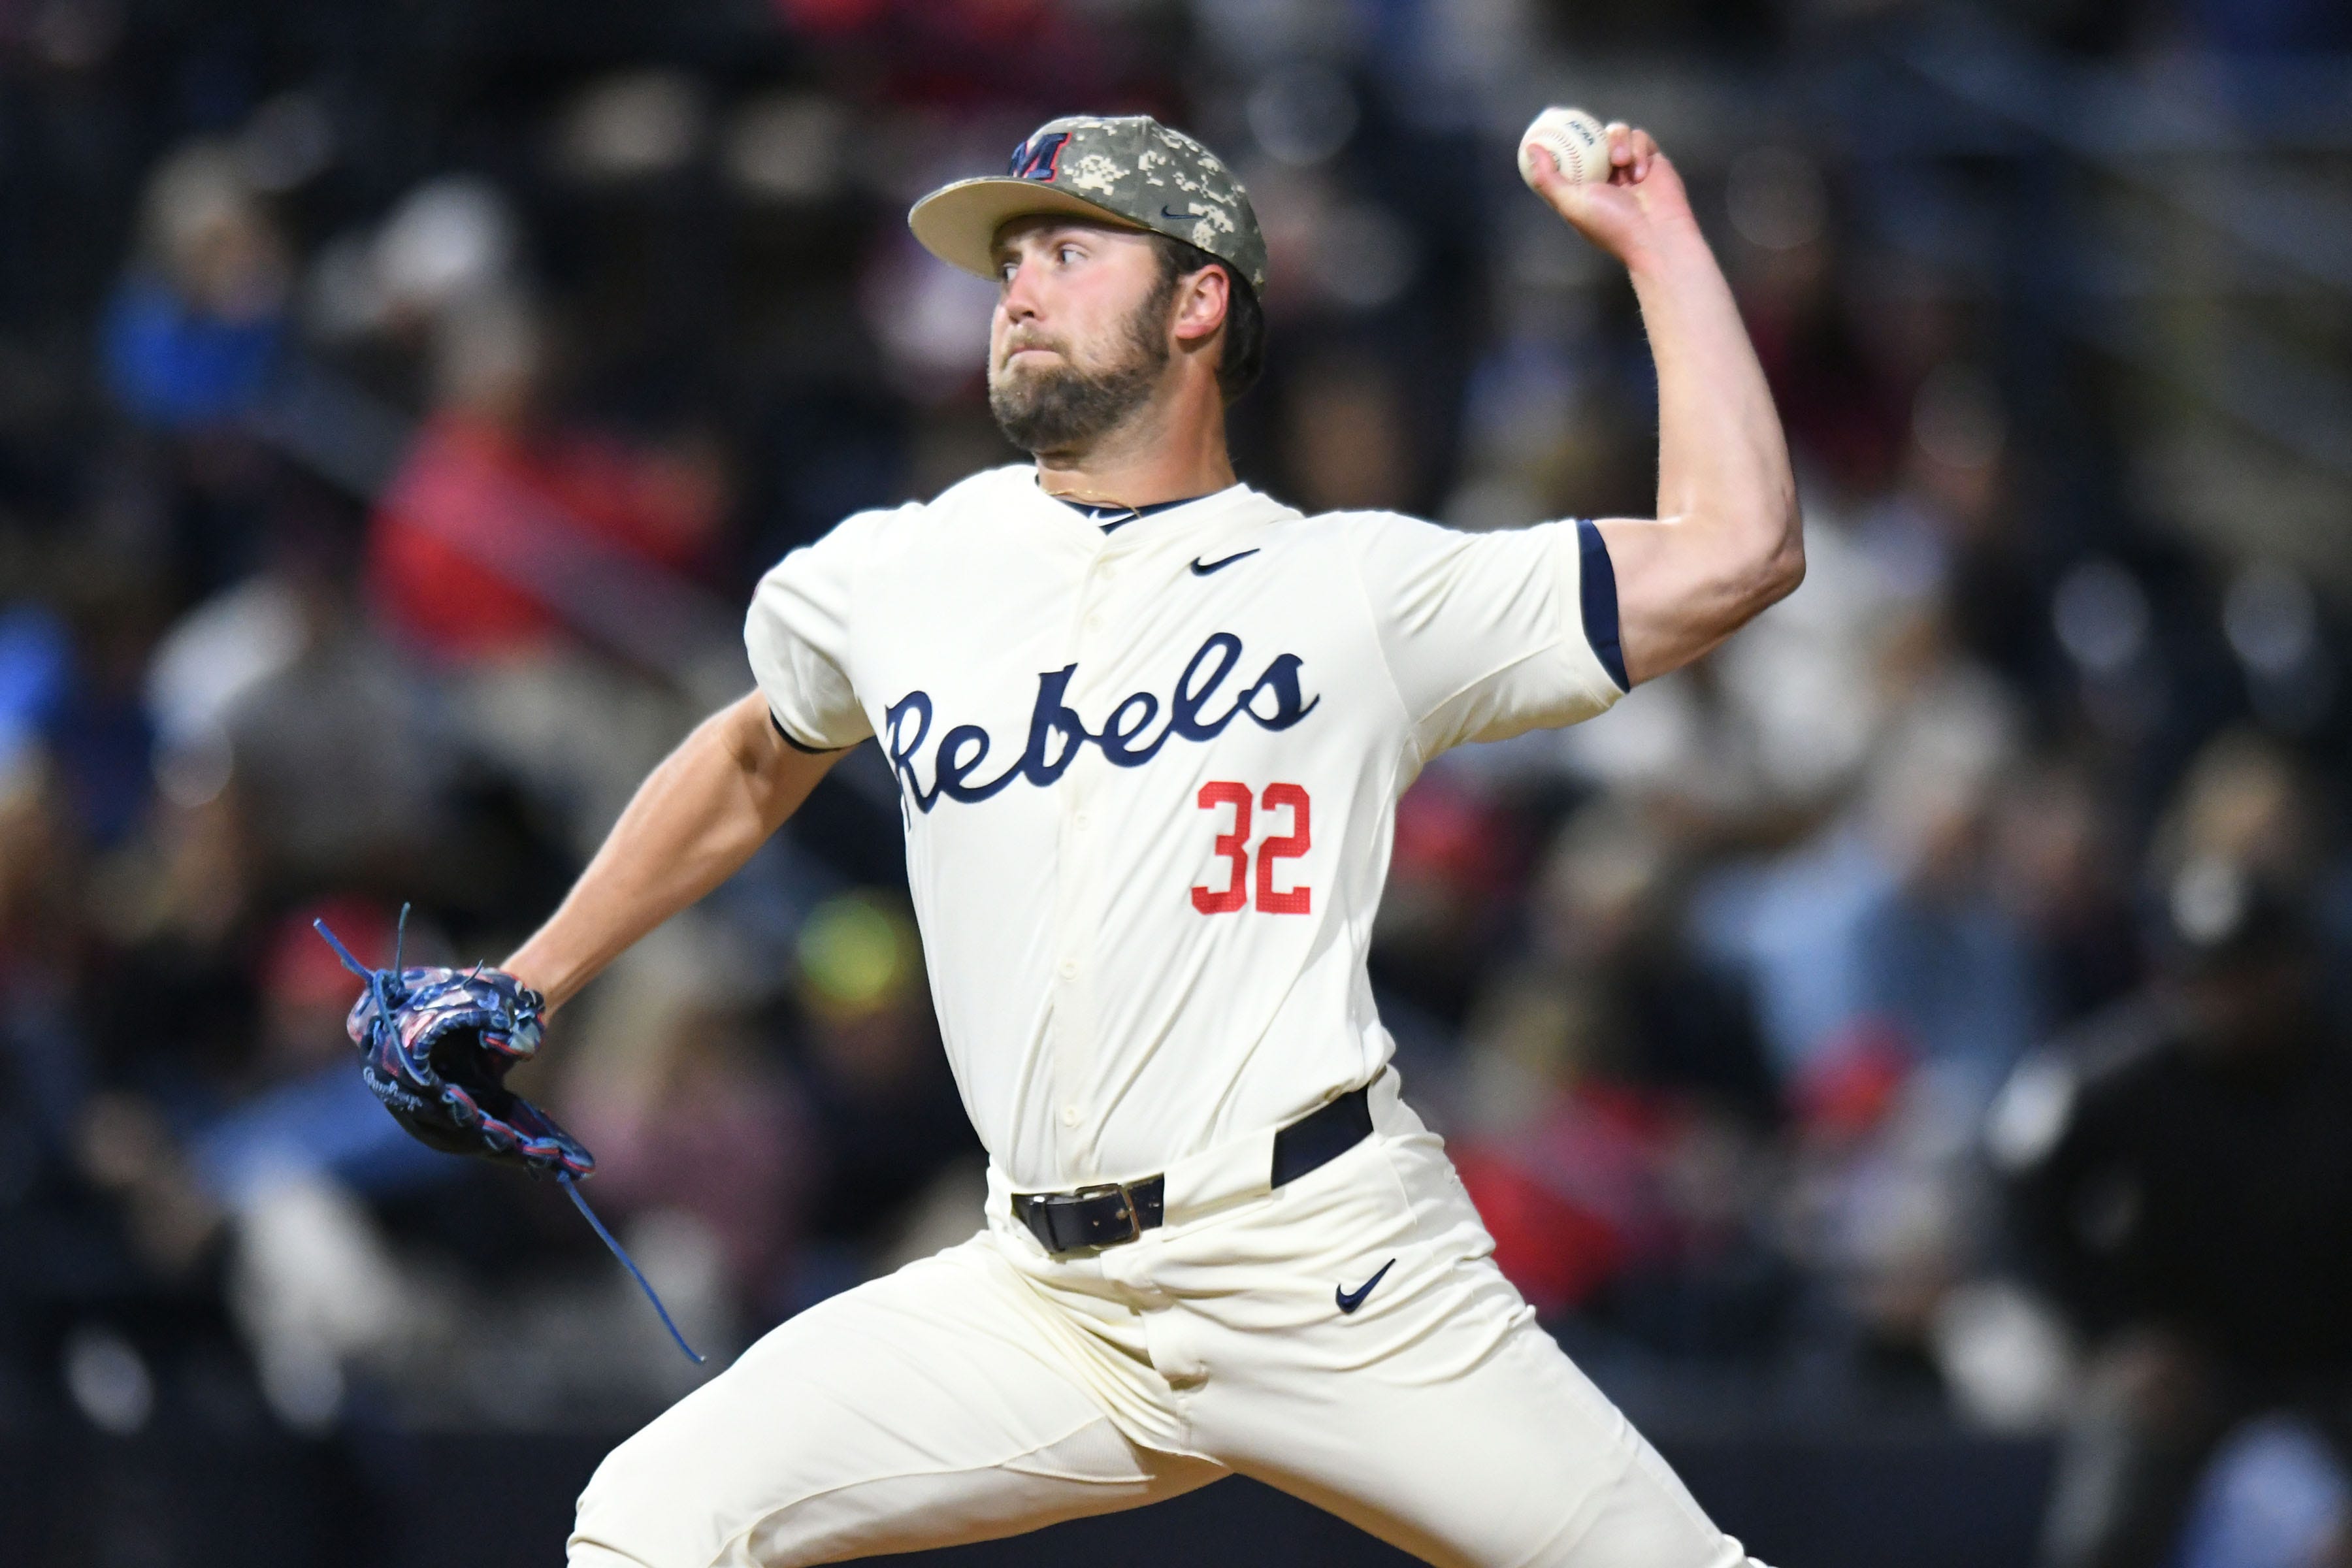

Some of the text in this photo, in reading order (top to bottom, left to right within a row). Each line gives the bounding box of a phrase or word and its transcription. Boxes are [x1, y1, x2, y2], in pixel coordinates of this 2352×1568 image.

[1007, 132, 1072, 182] M
[885, 632, 1320, 832] Rebels
[1191, 781, 1311, 915] 32
